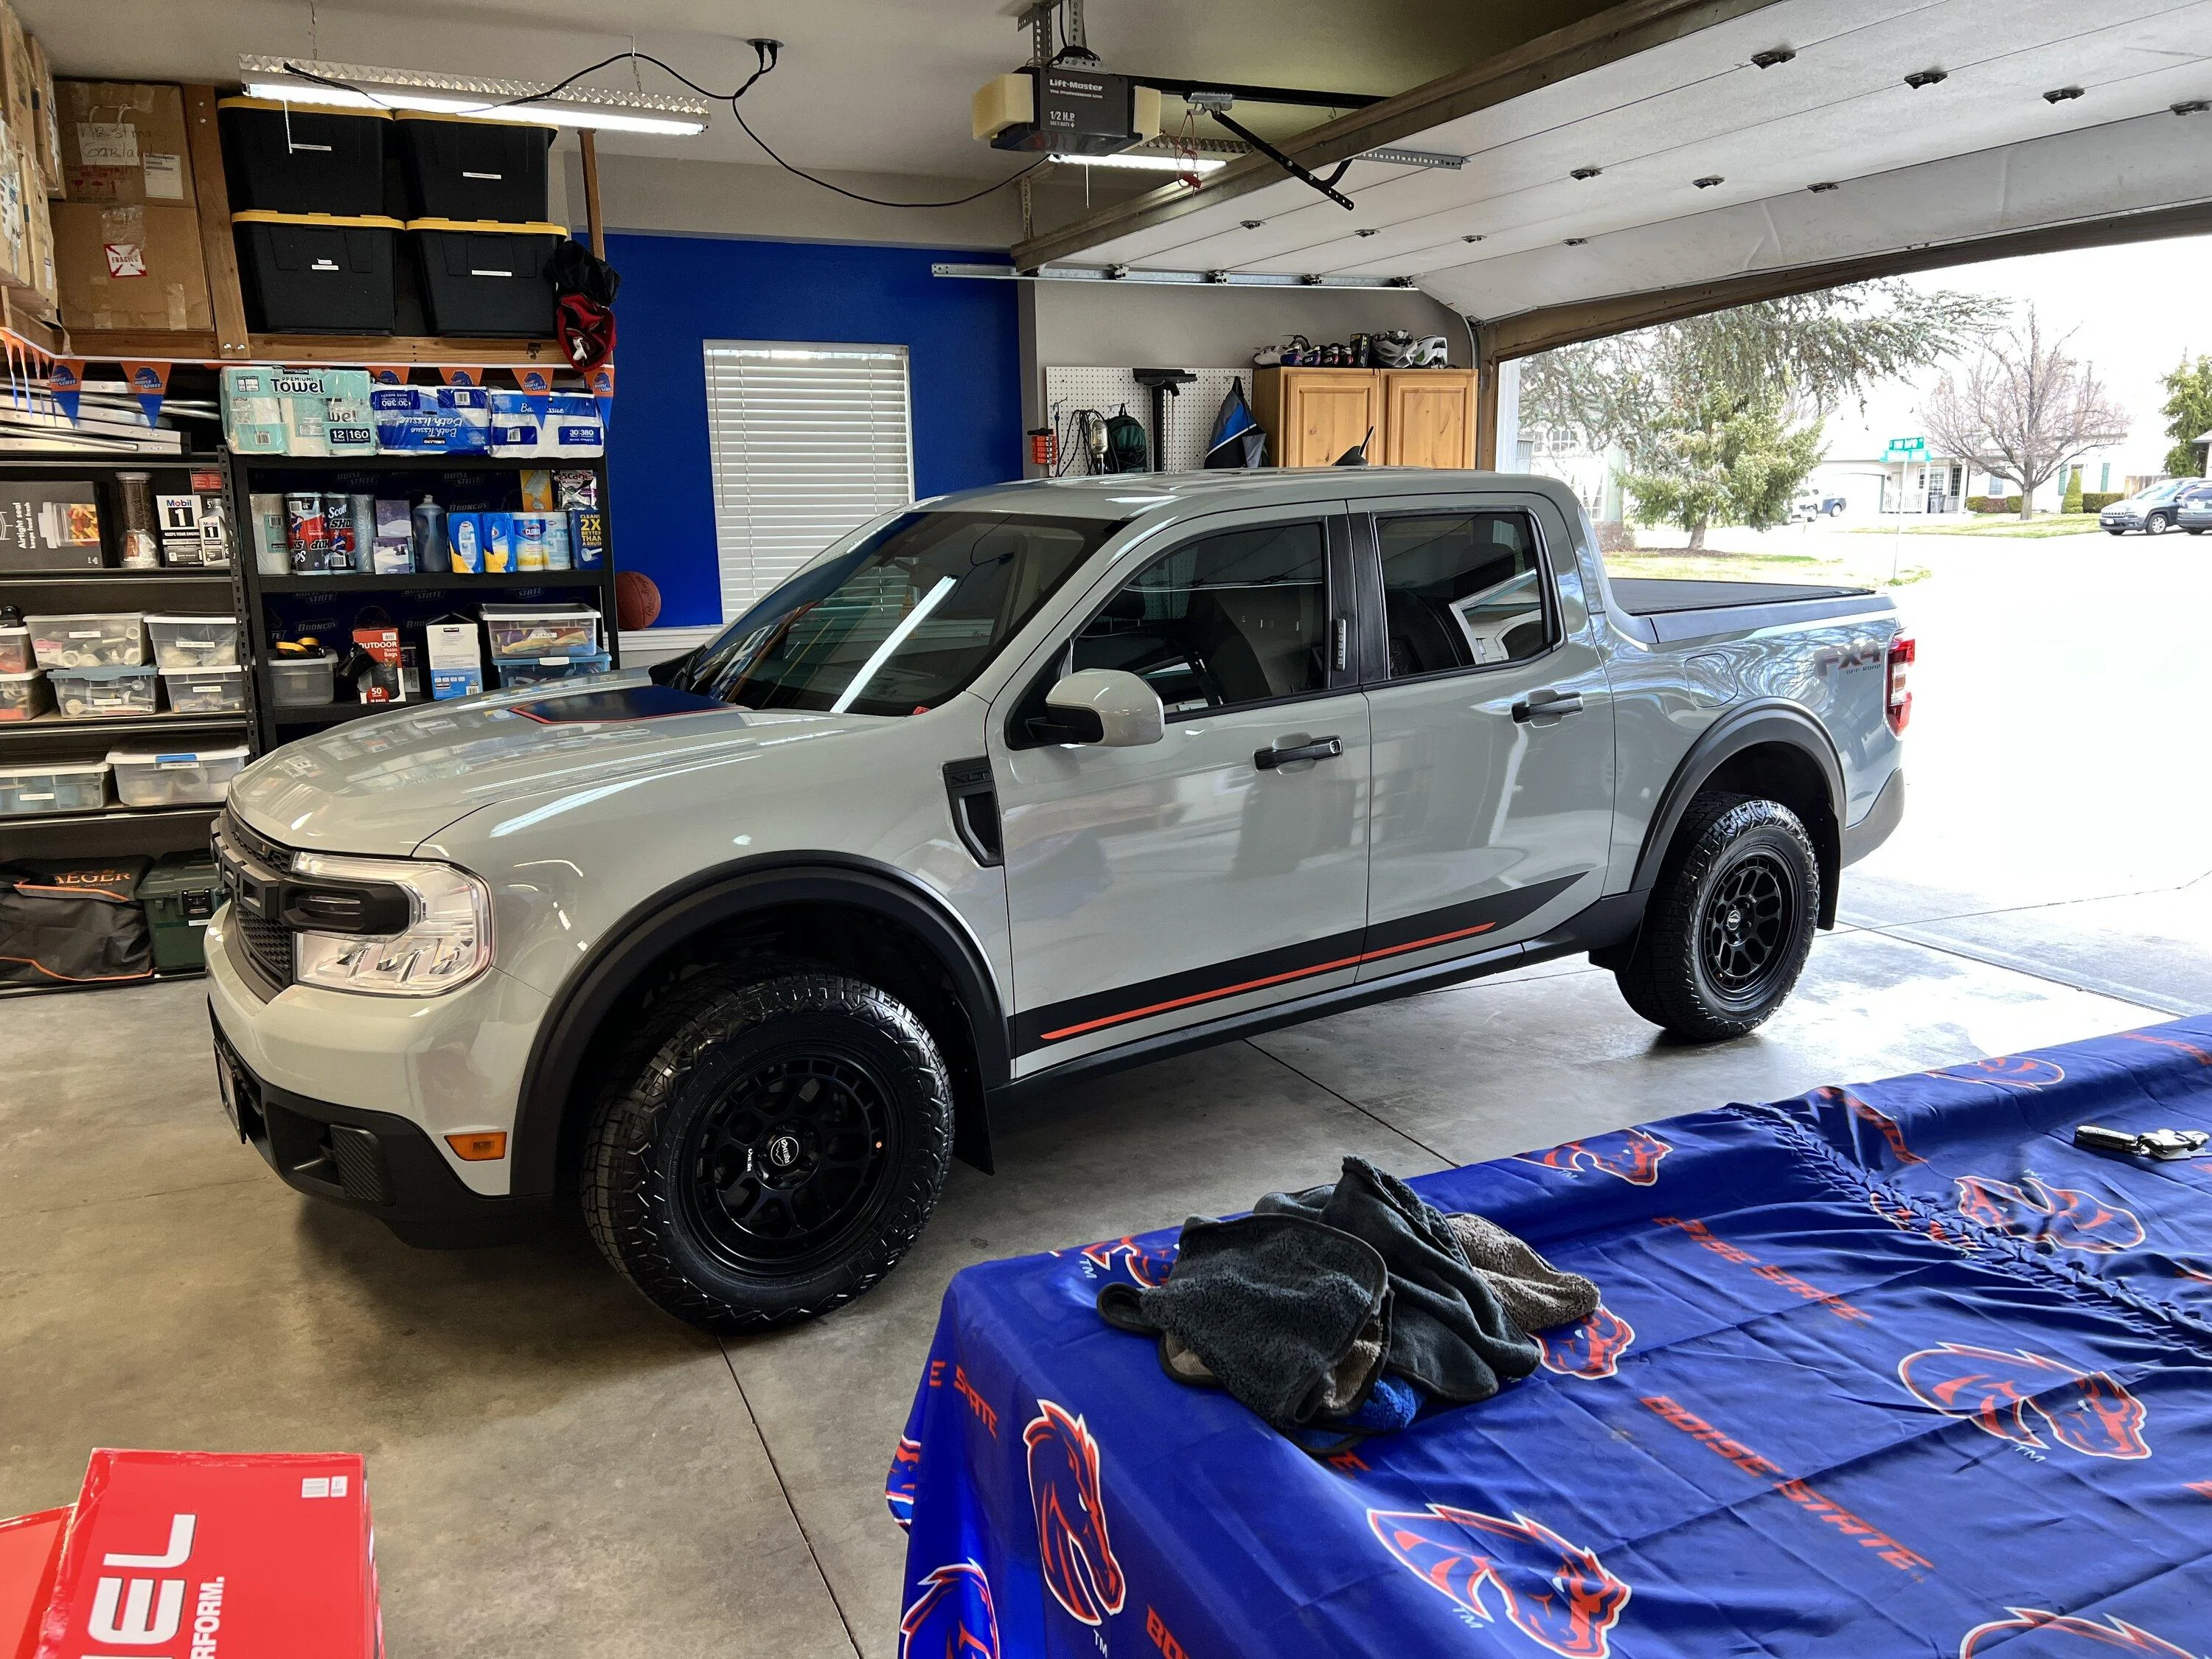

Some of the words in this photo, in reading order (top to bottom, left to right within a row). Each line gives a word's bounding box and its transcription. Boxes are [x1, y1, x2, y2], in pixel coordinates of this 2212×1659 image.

[1049, 79, 1102, 91] Lift-Master
[1049, 111, 1061, 120] 1/2
[271, 378, 324, 393] Towel
[328, 410, 358, 422] wel
[333, 430, 345, 439] 12
[349, 430, 369, 439] 160
[12, 502, 22, 518] seal
[175, 508, 186, 526] 1
[328, 504, 347, 518] Scott
[25, 517, 34, 531] food
[207, 526, 214, 537] 1
[580, 518, 601, 531] 2X
[15, 520, 27, 549] Airtight
[297, 622, 336, 633] BRONCOS
[1078, 1259, 1097, 1279] TM
[1750, 1265, 1873, 1321] STATE
[954, 1364, 998, 1440] STATE
[2014, 1445, 2047, 1463] TM
[1640, 1395, 1783, 1478] BOISE
[1773, 1477, 1935, 1571] STATE
[81, 1513, 198, 1659] EL
[192, 1576, 226, 1659] RFORM.
[1453, 1607, 1484, 1629] TM
[1093, 1628, 1107, 1658] TM
